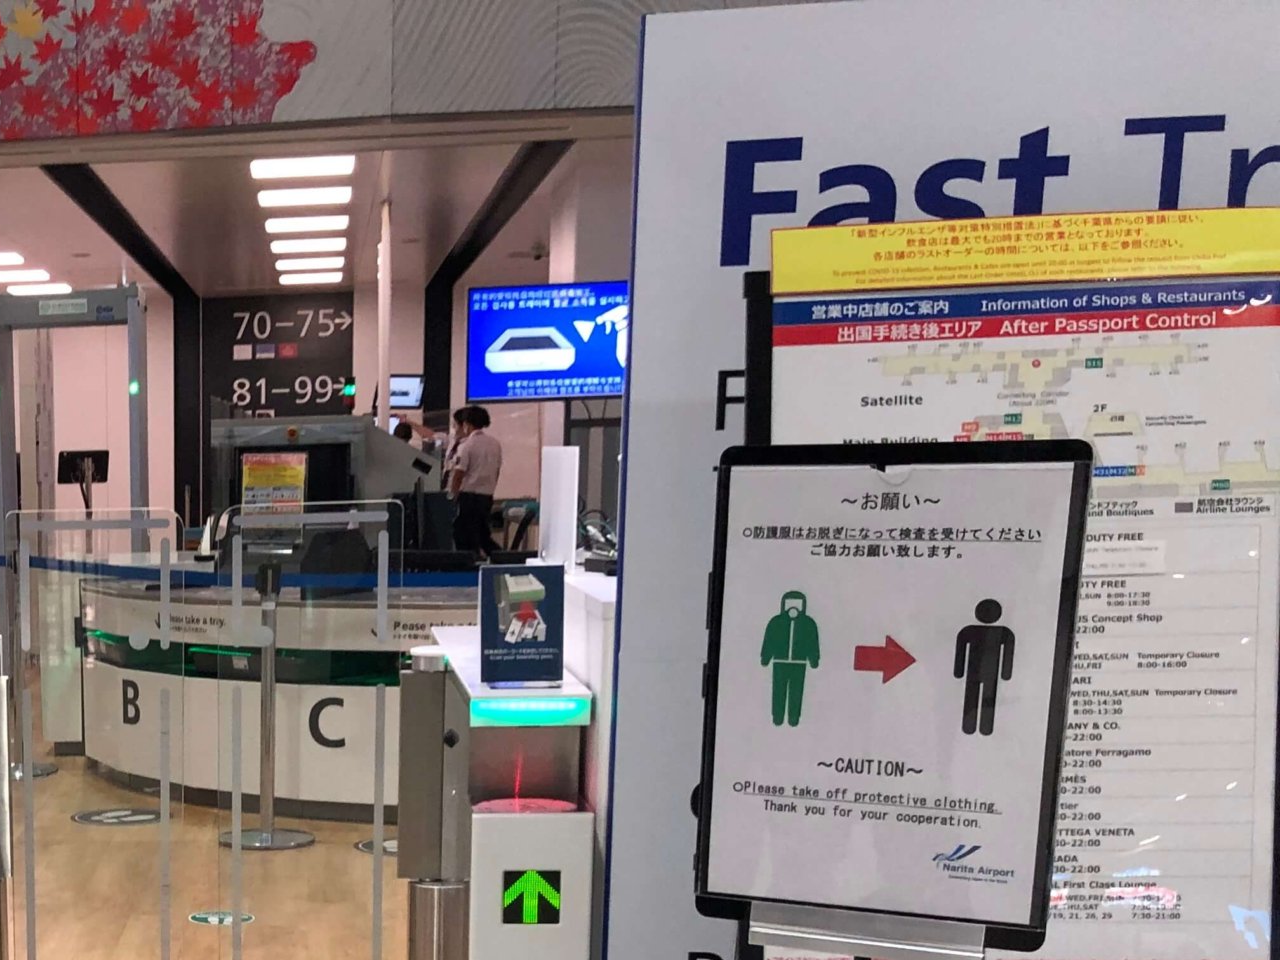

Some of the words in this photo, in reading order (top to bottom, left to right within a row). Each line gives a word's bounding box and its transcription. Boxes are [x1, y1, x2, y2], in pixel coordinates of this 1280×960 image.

[720, 126, 1070, 267] Fast
[981, 295, 1069, 312] Information
[1073, 295, 1088, 308] of
[1091, 292, 1137, 309] Shops
[1141, 291, 1153, 305] &
[1157, 288, 1245, 304] Restaurants
[811, 299, 949, 320] 営業中店舗のご案内
[1000, 318, 1049, 335] After
[1054, 313, 1140, 334] Passport
[1145, 310, 1217, 328] Control
[837, 320, 982, 341] 出国手続き後エリア
[860, 395, 924, 408] Satellite
[1106, 508, 1154, 517] Boutiques
[1196, 505, 1227, 514] Airline
[1230, 503, 1270, 514] Lounges
[1086, 533, 1114, 542] DUTY
[1118, 532, 1144, 541] FREE
[1100, 580, 1126, 588] FREE
[1092, 614, 1133, 624] Concept
[1136, 612, 1163, 623] Shop
[122, 679, 141, 725] B
[309, 697, 346, 748] C
[1095, 748, 1152, 758] Ferragamo
[792, 785, 820, 799] take
[826, 787, 847, 800] off
[854, 788, 927, 807] protective
[934, 793, 999, 814] clothing.
[763, 800, 798, 814] Thank
[804, 804, 825, 817] you
[833, 803, 853, 818] for
[860, 808, 888, 822] your
[896, 811, 982, 828] cooperation.
[1094, 828, 1135, 837] VENETA
[978, 866, 1015, 878] Airport
[1063, 880, 1085, 889] First
[1089, 880, 1116, 889] Class
